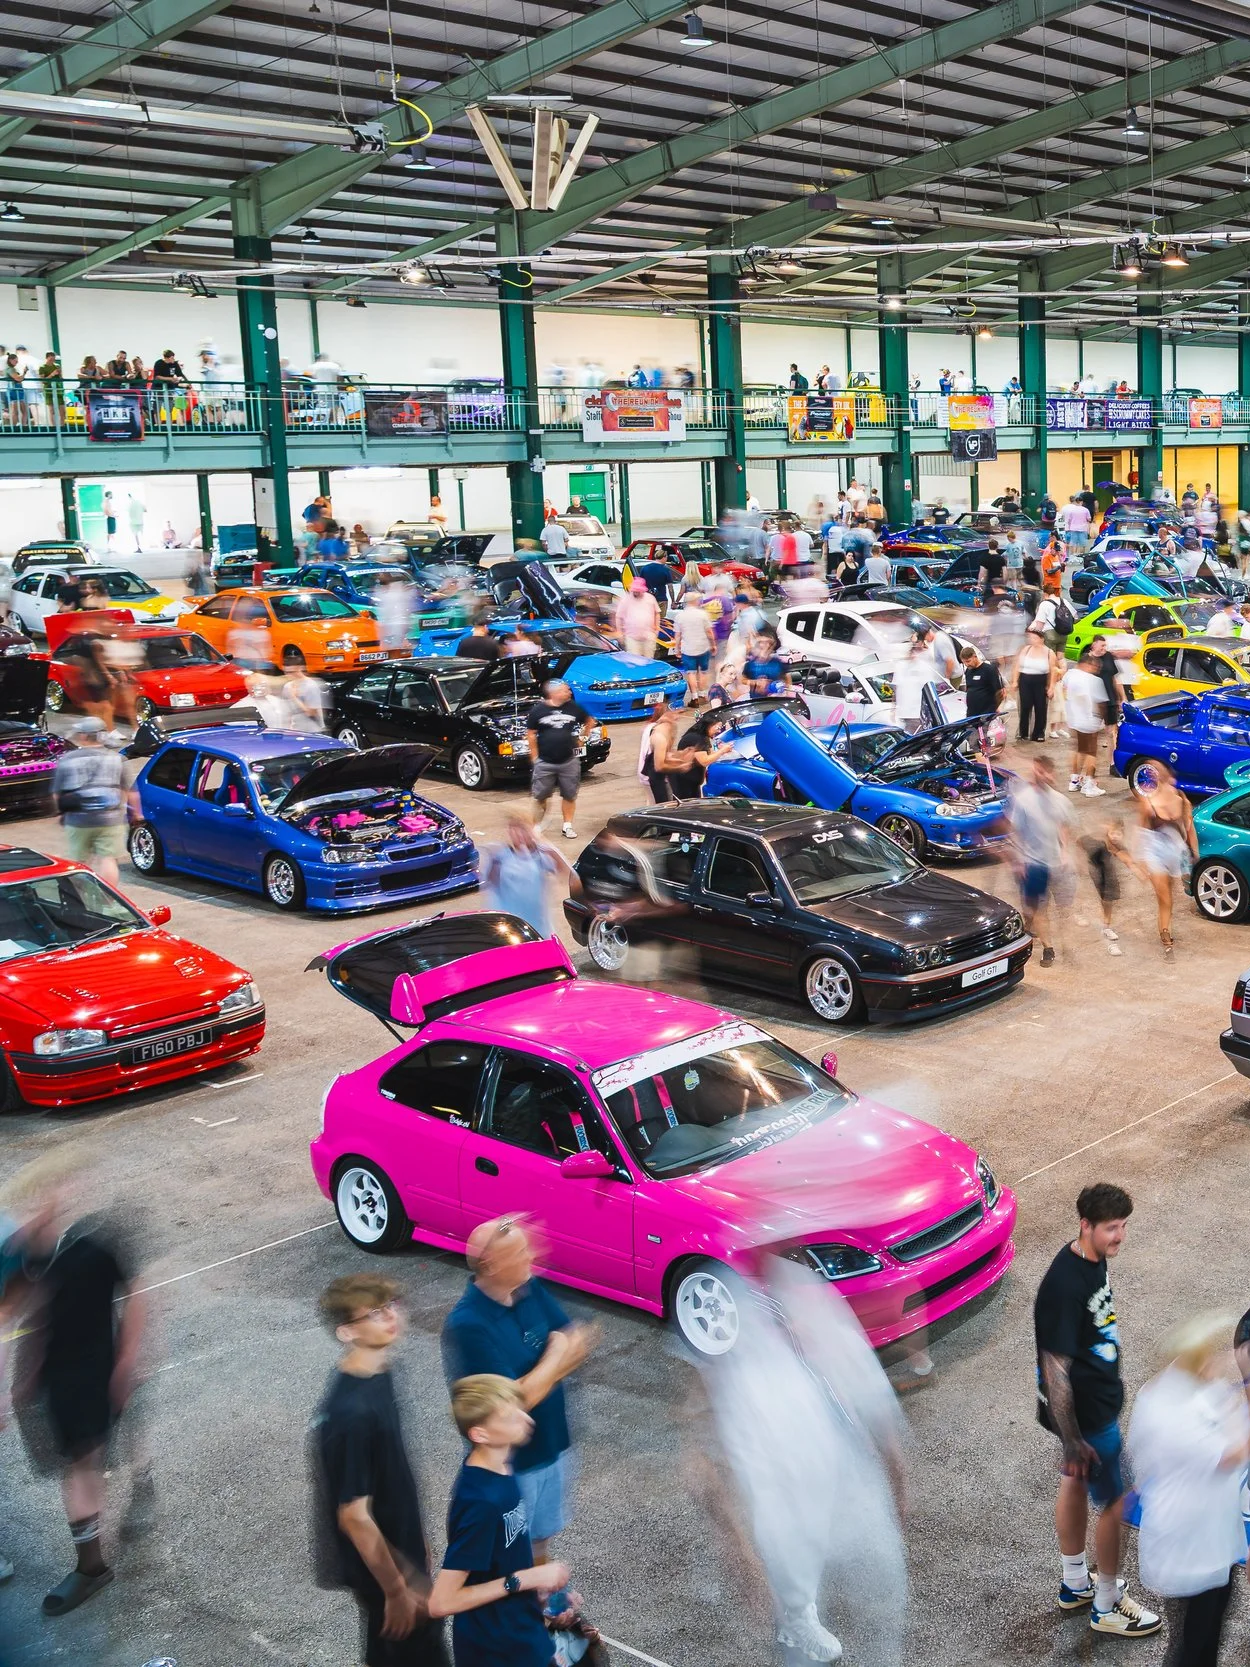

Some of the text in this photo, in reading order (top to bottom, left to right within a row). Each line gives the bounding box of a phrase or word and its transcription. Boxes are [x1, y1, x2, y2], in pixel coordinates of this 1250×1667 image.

[1108, 421, 1151, 429] LIGHT BITES
[972, 965, 997, 981] Golf GTI
[141, 1031, 204, 1060] F160 PBJ
